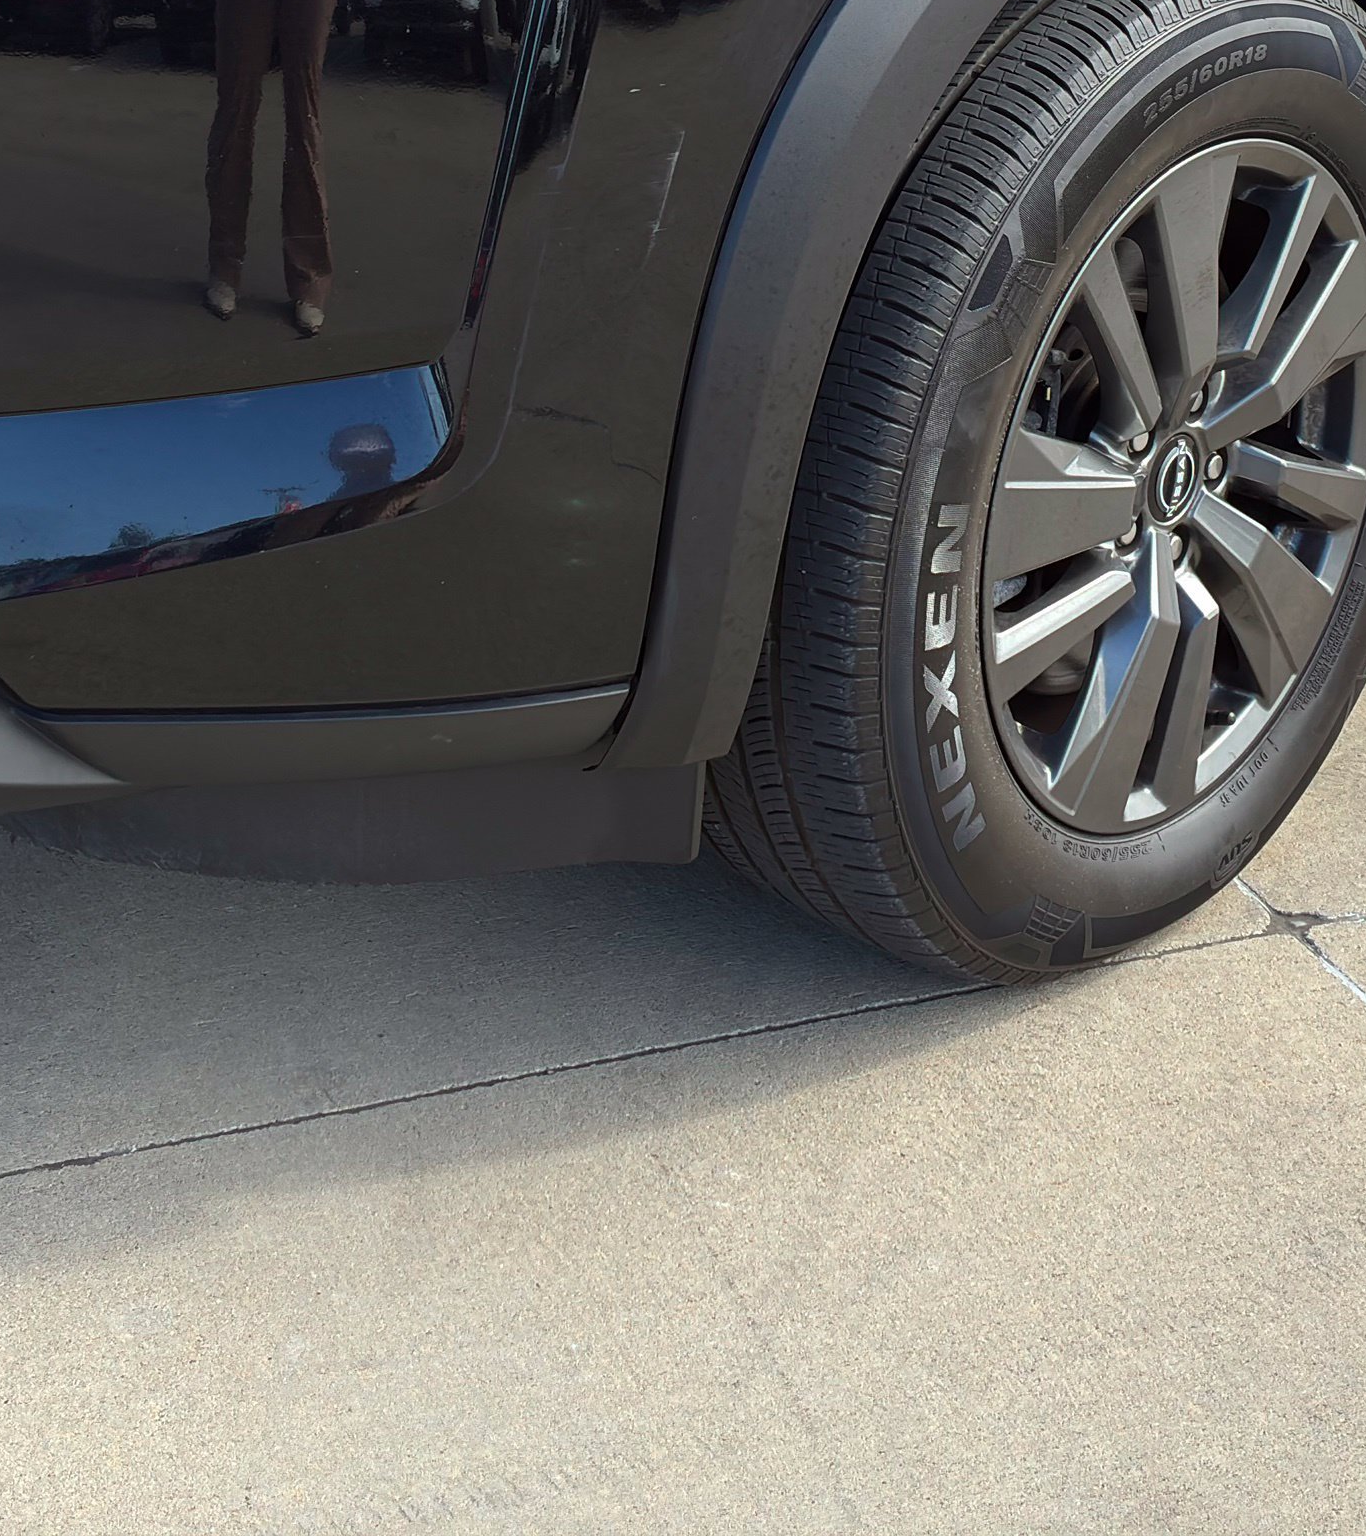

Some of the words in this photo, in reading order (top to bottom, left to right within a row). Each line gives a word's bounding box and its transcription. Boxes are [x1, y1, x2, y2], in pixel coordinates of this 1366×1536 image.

[1143, 43, 1268, 129] 255/60R18
[1165, 438, 1187, 518] NISSAN
[923, 503, 987, 853] NEXEN
[1219, 829, 1254, 871] SUV
